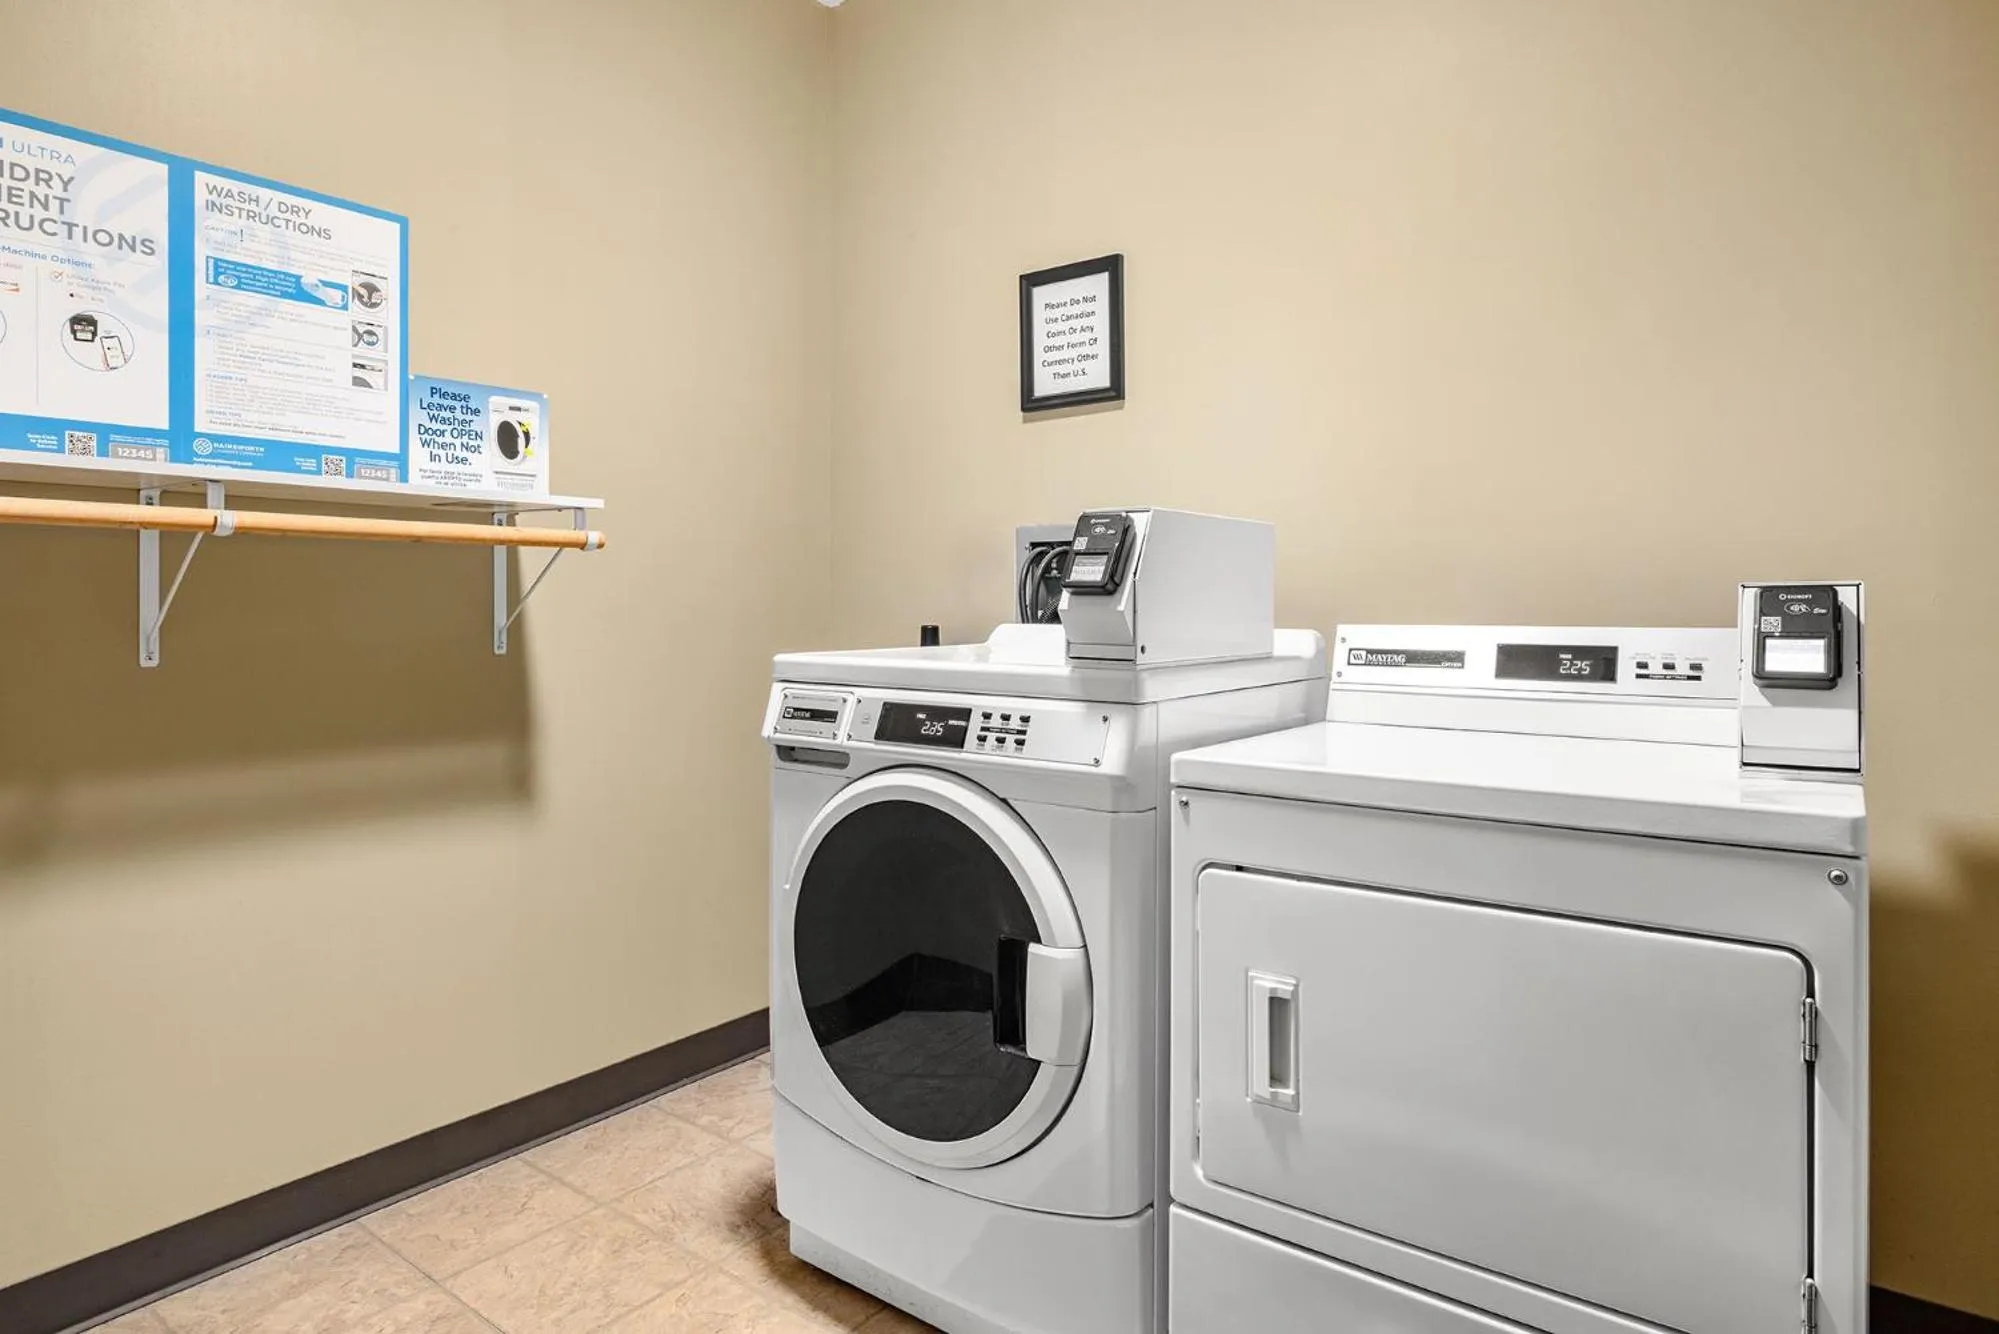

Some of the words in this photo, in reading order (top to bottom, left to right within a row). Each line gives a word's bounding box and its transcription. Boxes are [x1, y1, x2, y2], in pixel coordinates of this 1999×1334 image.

[12, 139, 77, 167] ULTRA
[0, 161, 75, 192] DRY
[0, 183, 71, 215] ENT
[205, 183, 260, 208] WASH
[263, 198, 273, 211] /
[278, 201, 312, 220] DRY
[205, 199, 333, 241] INSTRUCTIONS
[1044, 300, 1067, 311] Please
[1069, 297, 1080, 306] Do
[1082, 294, 1097, 304] Not
[1044, 316, 1059, 325] Use
[1060, 310, 1096, 322] Canadian
[1046, 330, 1067, 339] Coins
[1068, 327, 1077, 335] Or
[1079, 324, 1095, 335] Any
[1043, 343, 1065, 354] Other
[1067, 340, 1087, 350] Form
[1088, 336, 1098, 346] Of
[1042, 356, 1075, 369] Currency
[1076, 352, 1099, 362] Other
[1072, 368, 1088, 377] U.S.
[430, 386, 471, 403] Please
[419, 398, 458, 414] Leave
[460, 403, 481, 417] the
[427, 411, 474, 428] Washer
[418, 423, 447, 438] Door
[450, 427, 483, 441] OPEN
[117, 447, 153, 460] 12345
[419, 437, 456, 451] When
[460, 441, 482, 454] Not
[429, 451, 441, 463] In
[445, 453, 472, 466] Use.
[1366, 653, 1407, 663] MAYTAG
